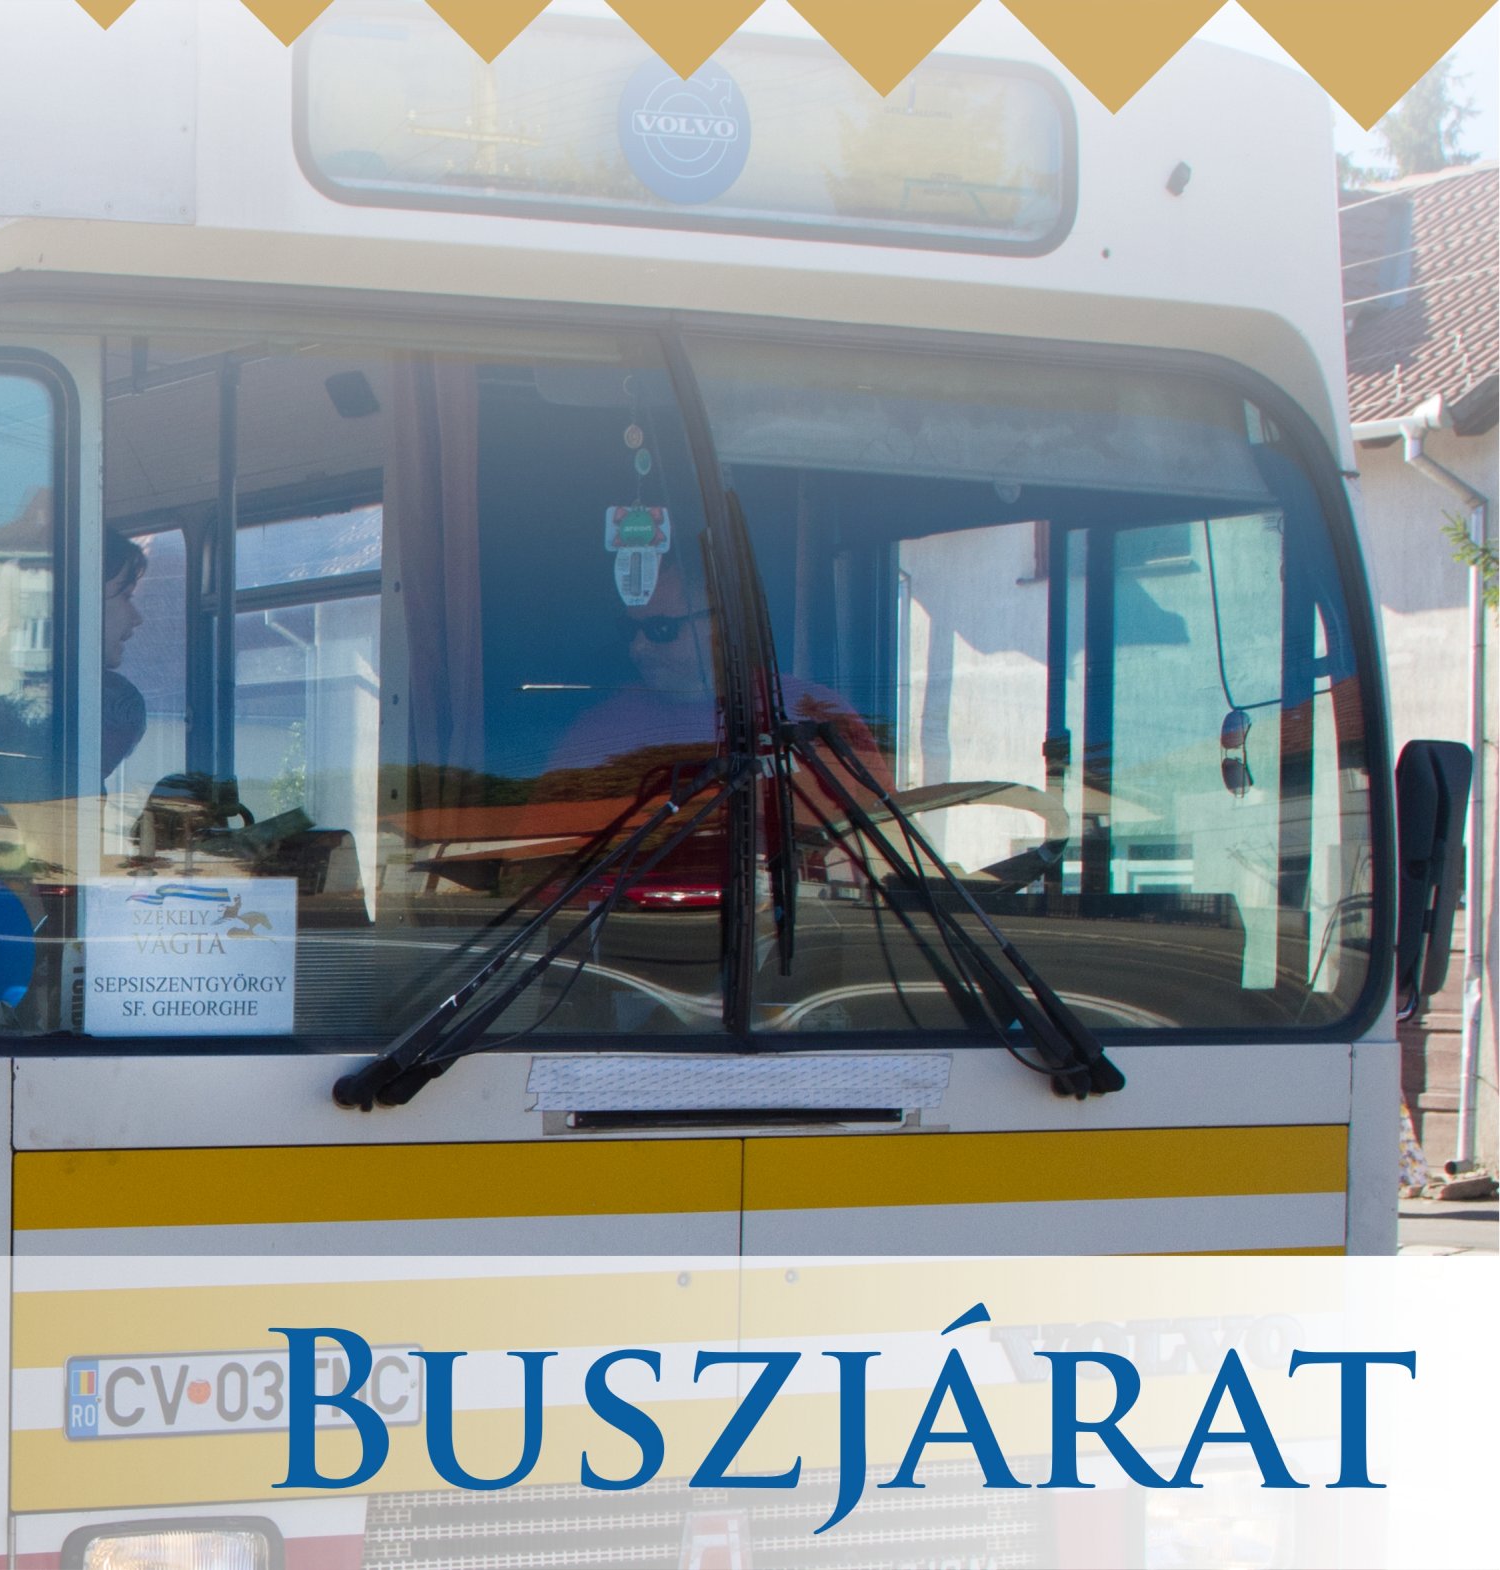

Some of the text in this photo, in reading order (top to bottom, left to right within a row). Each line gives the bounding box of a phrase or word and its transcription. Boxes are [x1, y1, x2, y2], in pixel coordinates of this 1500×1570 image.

[635, 113, 736, 138] VOLVO
[132, 906, 211, 926] SZÉKELY
[132, 926, 227, 955] VÁGTA
[93, 973, 287, 993] SEPSISZENTGYÖRGY
[121, 1000, 258, 1017] SF. GHEORGHE
[986, 1313, 1306, 1385] VOLVO
[104, 1364, 190, 1428] CV
[216, 1359, 284, 1423] 03
[71, 1403, 97, 1428] RO
